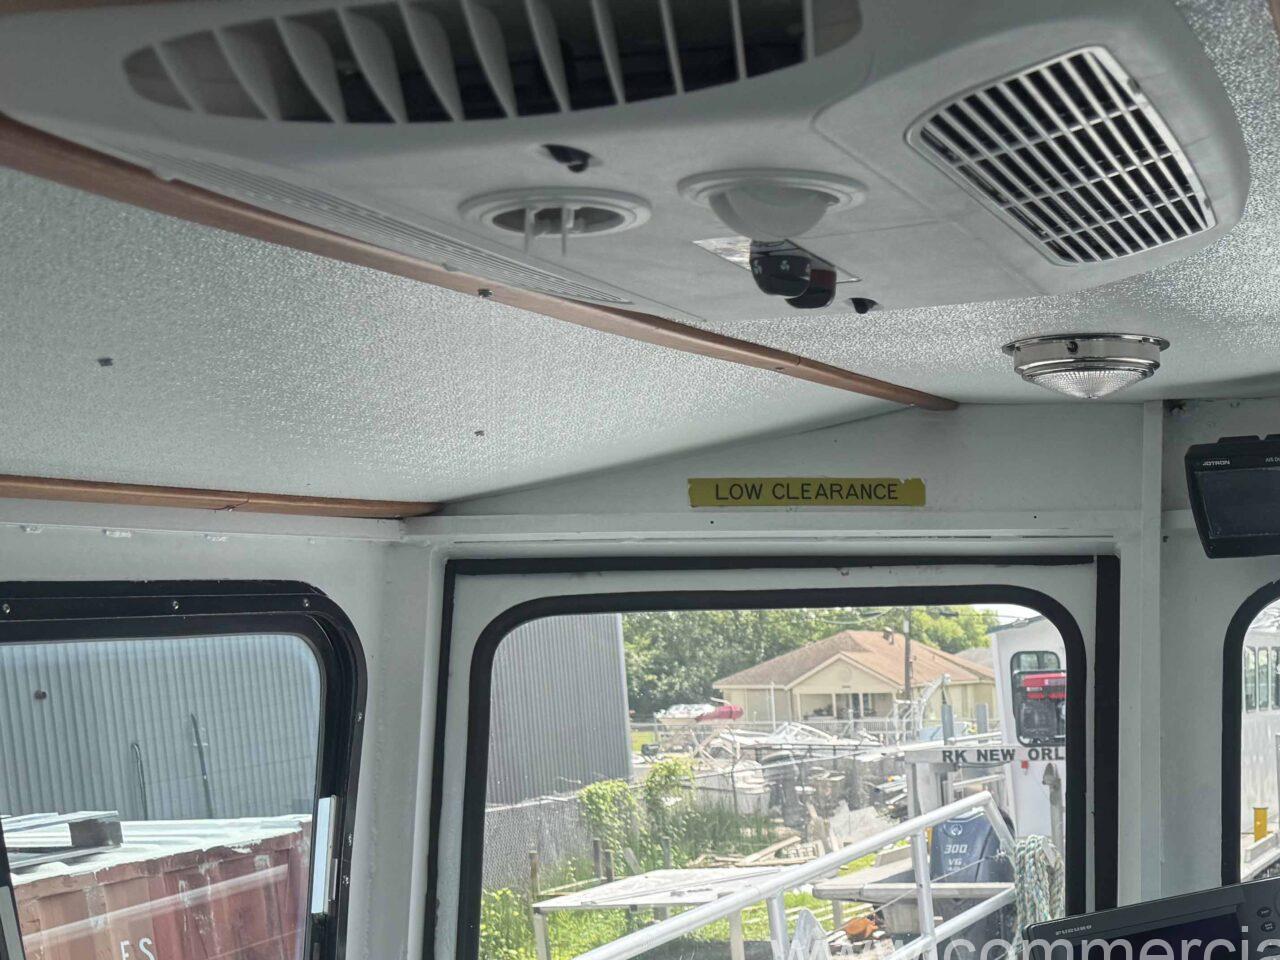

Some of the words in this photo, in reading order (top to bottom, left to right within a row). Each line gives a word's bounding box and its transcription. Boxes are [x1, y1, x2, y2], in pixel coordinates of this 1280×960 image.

[715, 483, 763, 500] LOW
[772, 483, 899, 500] CLEARANCE
[977, 749, 1015, 762] NEW
[944, 844, 968, 854] 300
[1054, 924, 1093, 936] FURUNO
